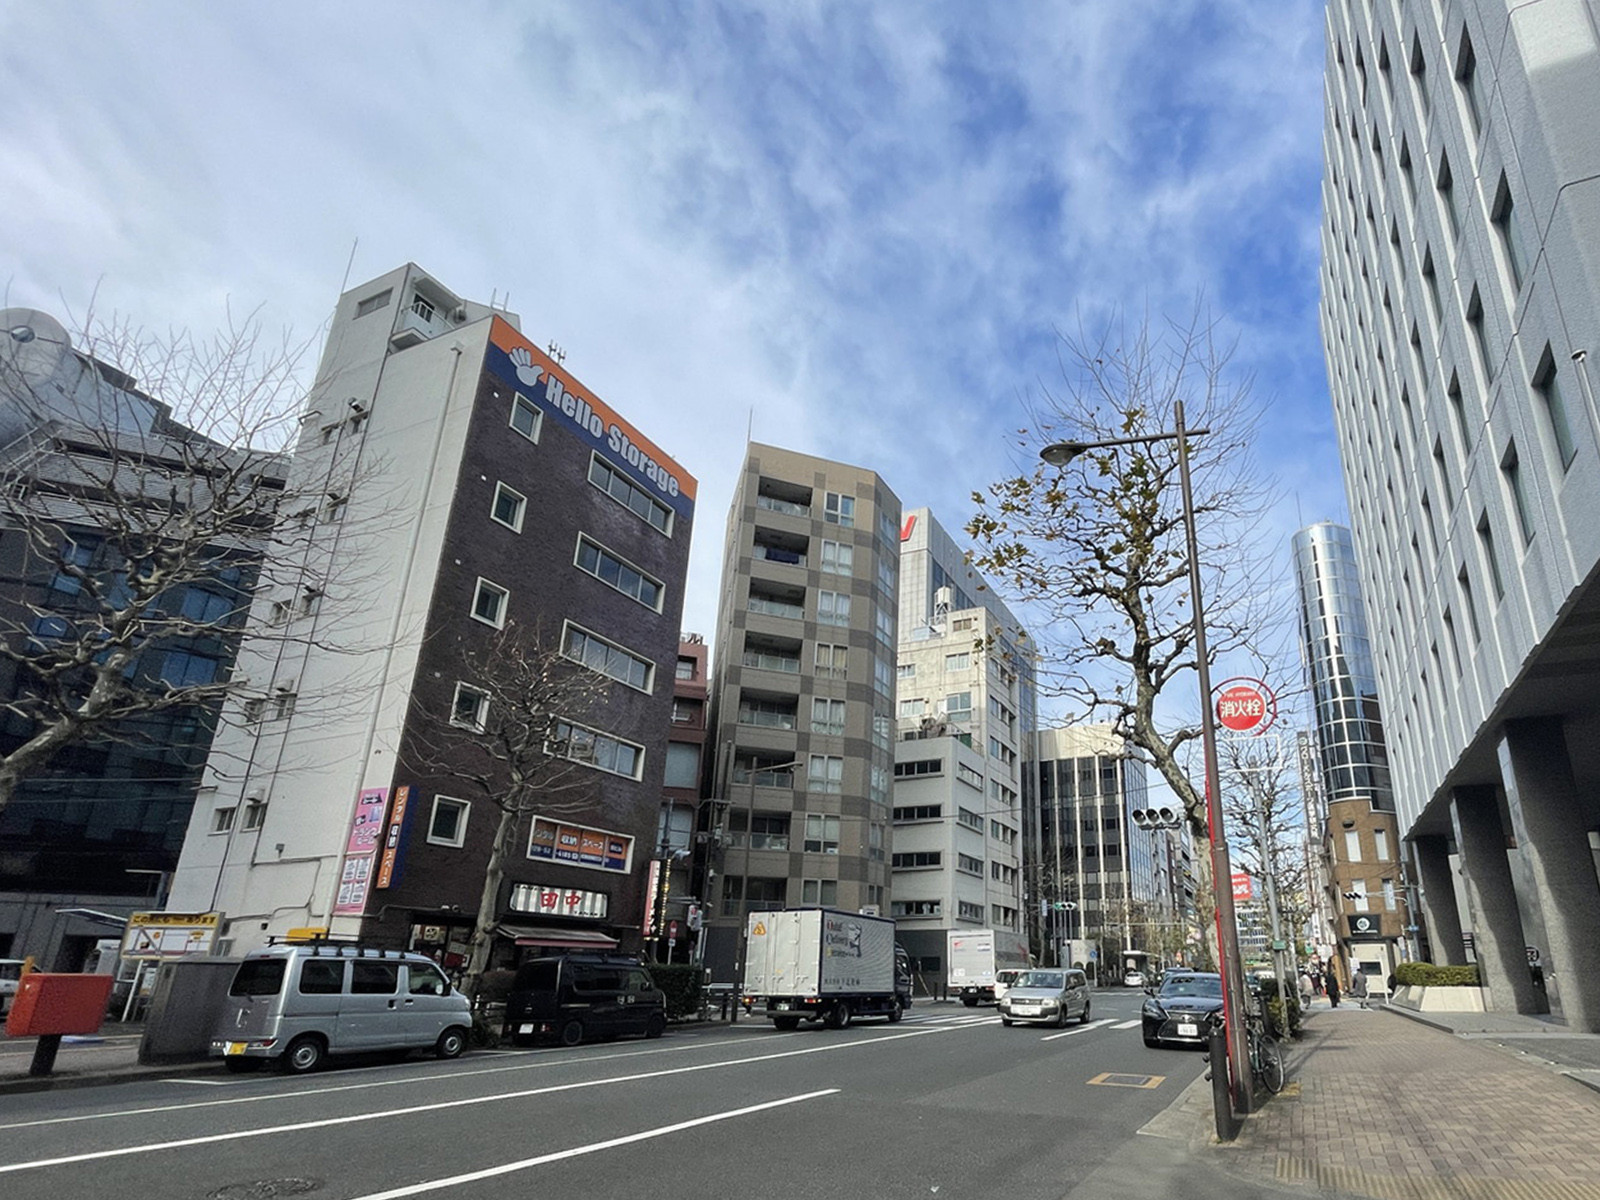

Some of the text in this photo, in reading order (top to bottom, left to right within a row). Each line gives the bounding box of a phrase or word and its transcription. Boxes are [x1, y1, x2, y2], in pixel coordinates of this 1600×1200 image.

[546, 374, 679, 496] Hello Storage
[1220, 698, 1262, 718] 消火栓
[582, 838, 604, 849] スペース
[381, 851, 394, 886] スペース
[540, 889, 581, 909] 田中
